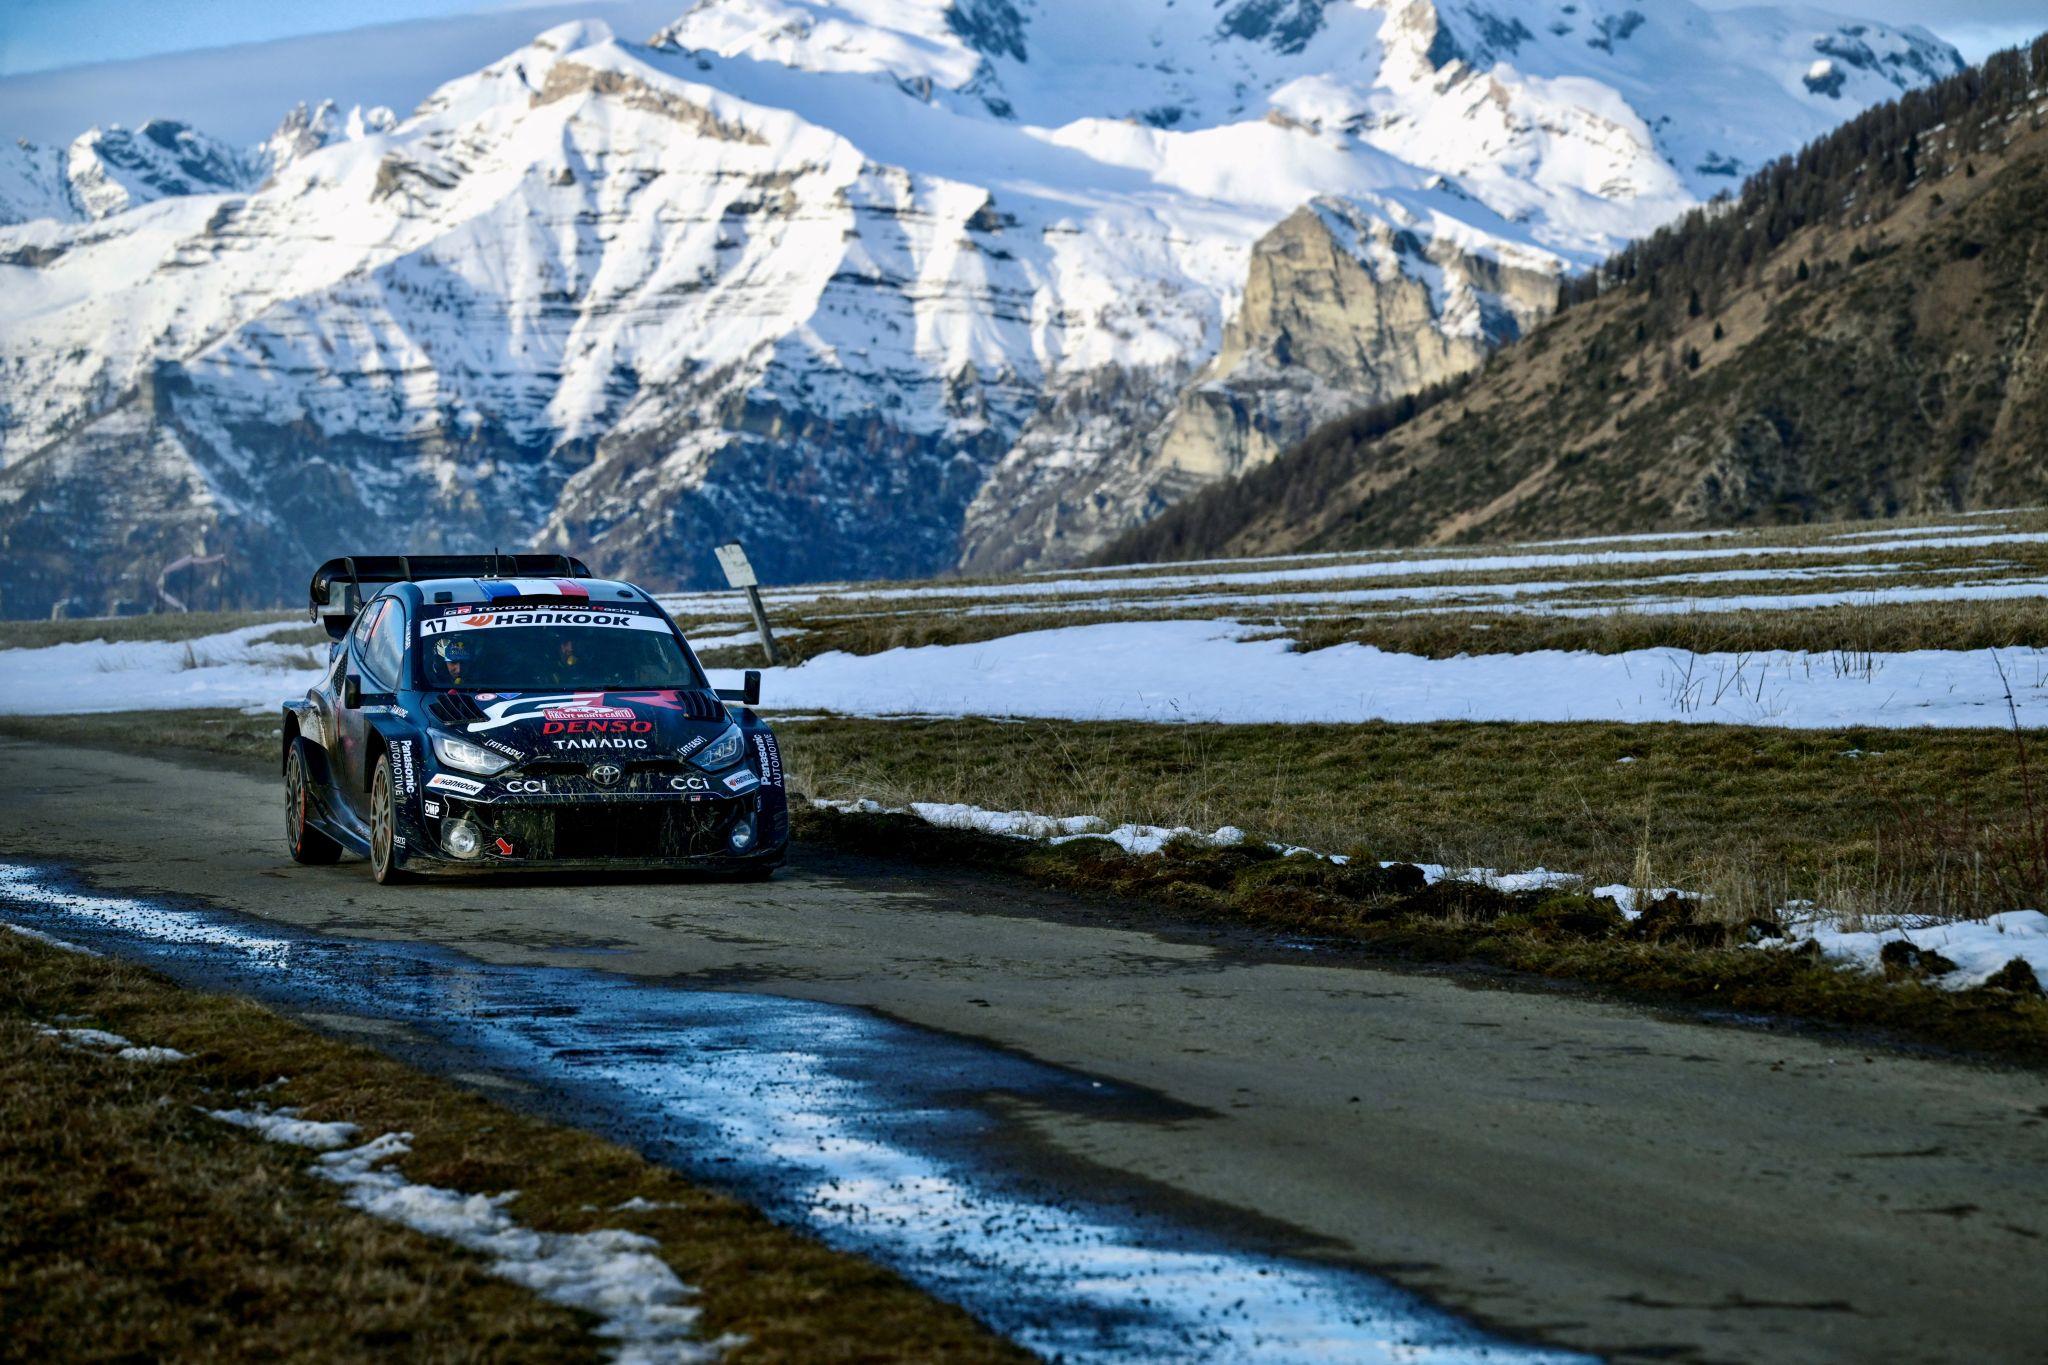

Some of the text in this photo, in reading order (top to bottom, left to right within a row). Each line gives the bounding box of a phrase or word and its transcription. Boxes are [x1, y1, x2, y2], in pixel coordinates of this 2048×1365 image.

[444, 606, 472, 616] GR
[592, 605, 640, 615] Racing
[425, 619, 447, 633] 17
[548, 708, 576, 719] RALLYE
[543, 720, 652, 735] DENSO
[553, 738, 648, 750] TAMADIC
[401, 740, 415, 794] Panasonic
[753, 734, 771, 786] Panasonic
[764, 733, 782, 788] AUTOMOTIVE
[389, 740, 404, 796] AUTOMOTIVE
[424, 802, 440, 816] OMP
